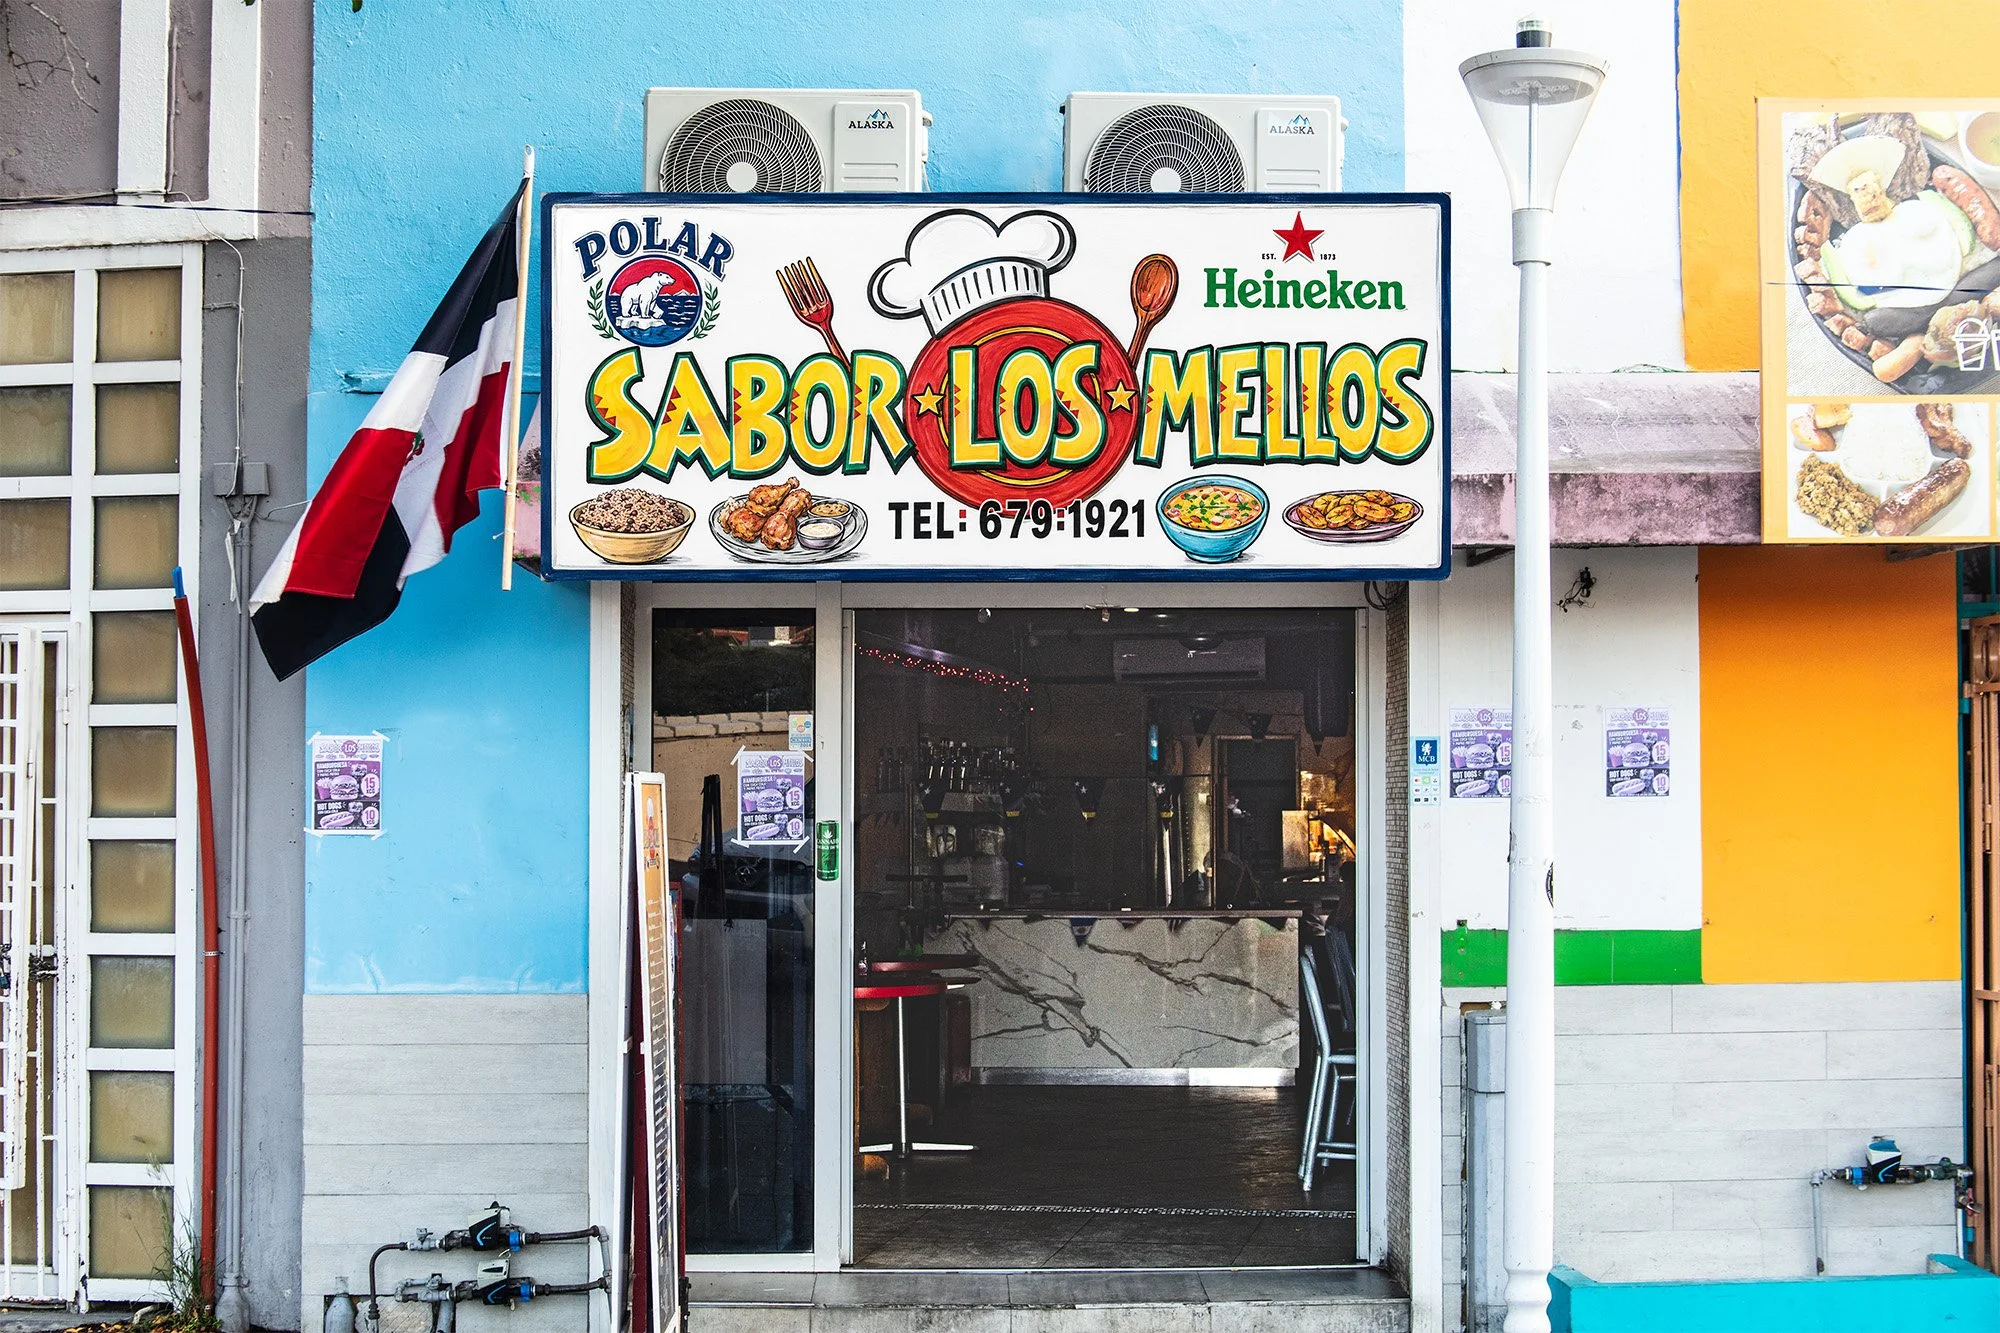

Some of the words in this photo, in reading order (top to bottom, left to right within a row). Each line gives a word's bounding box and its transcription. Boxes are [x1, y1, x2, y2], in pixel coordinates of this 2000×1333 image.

[848, 121, 894, 129] ALASKA
[1269, 125, 1315, 135] ALASKA
[575, 216, 734, 282] POLAR
[1320, 253, 1337, 261] 1873
[1204, 268, 1406, 310] Heineken
[586, 346, 916, 484] SABOR
[949, 340, 1108, 471] LOS
[1133, 338, 1435, 469] MELLOS
[888, 501, 967, 540] TEL:
[979, 499, 1146, 540] 679:1921
[344, 743, 357, 753] LOS
[1500, 746, 1511, 757] 15
[1655, 745, 1666, 755] 15
[769, 759, 781, 768] LOS
[365, 777, 375, 788] 15
[1501, 778, 1511, 787] 10
[1656, 777, 1666, 786] 10
[789, 791, 800, 801] 15
[365, 810, 375, 820] 10
[790, 822, 800, 830] 10
